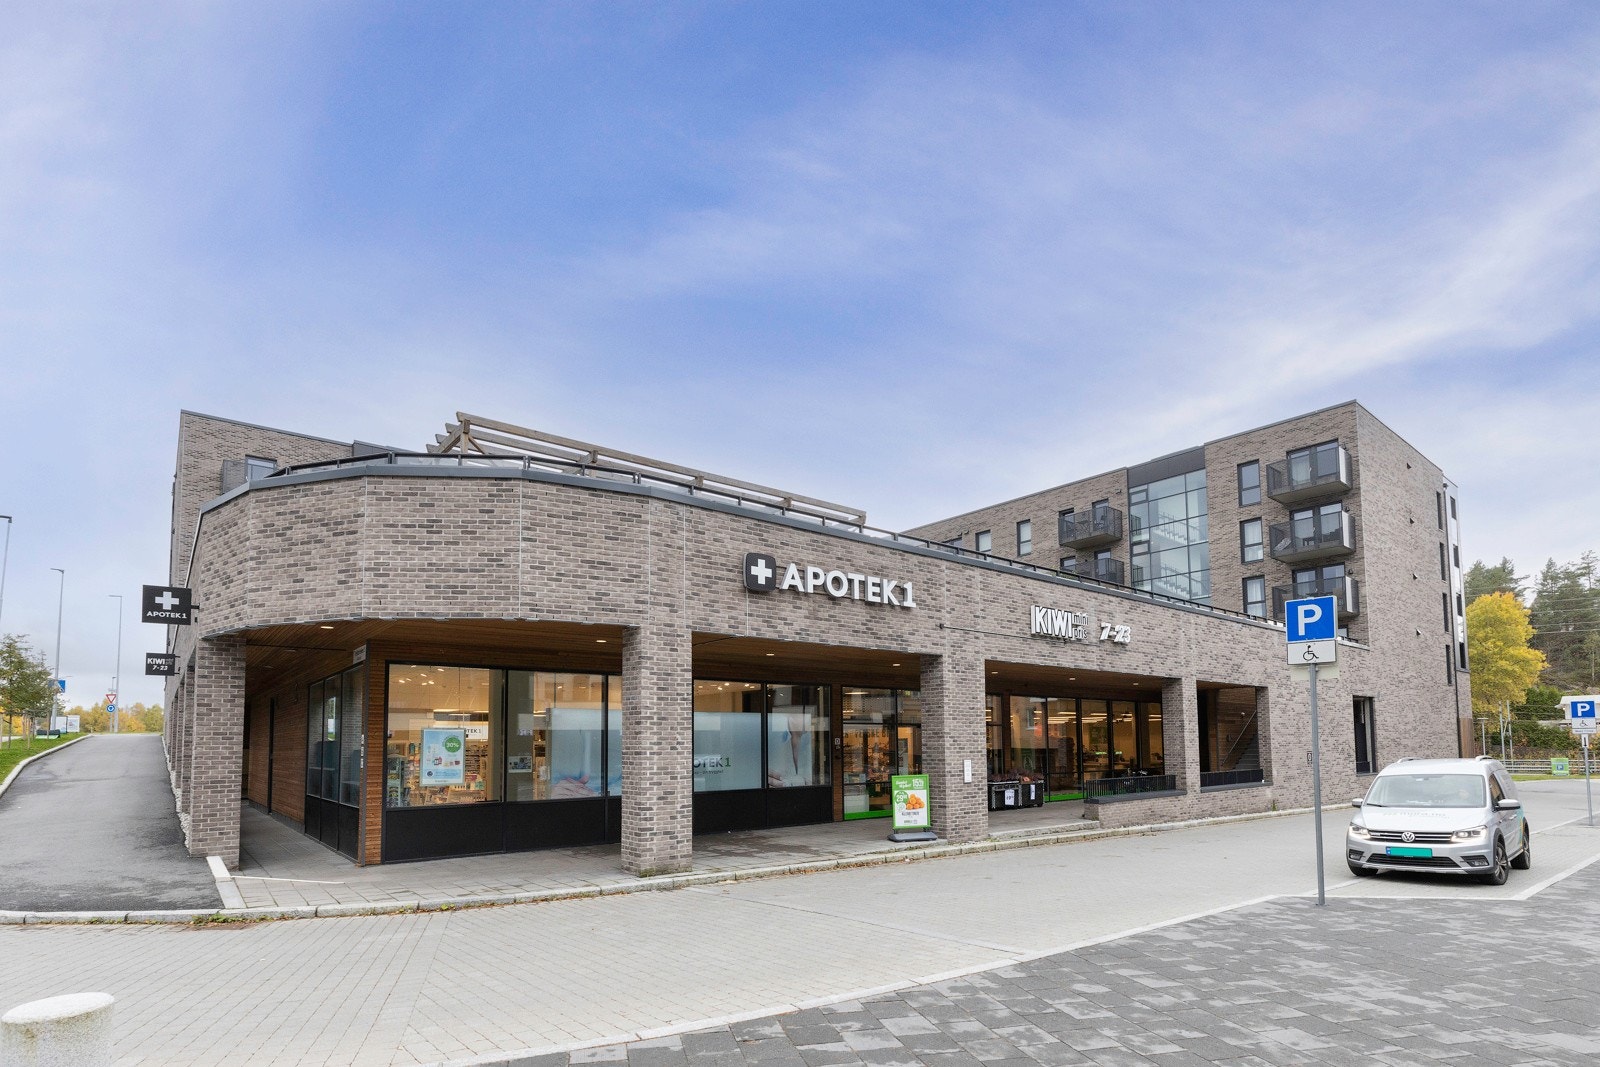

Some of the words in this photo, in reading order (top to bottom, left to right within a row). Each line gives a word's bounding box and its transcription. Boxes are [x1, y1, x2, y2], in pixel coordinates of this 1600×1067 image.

[1031, 605, 1073, 638] KIWI
[1297, 604, 1322, 636] P
[1100, 621, 1131, 643] 7-23
[147, 657, 166, 665] KIWI
[1577, 703, 1590, 717] P
